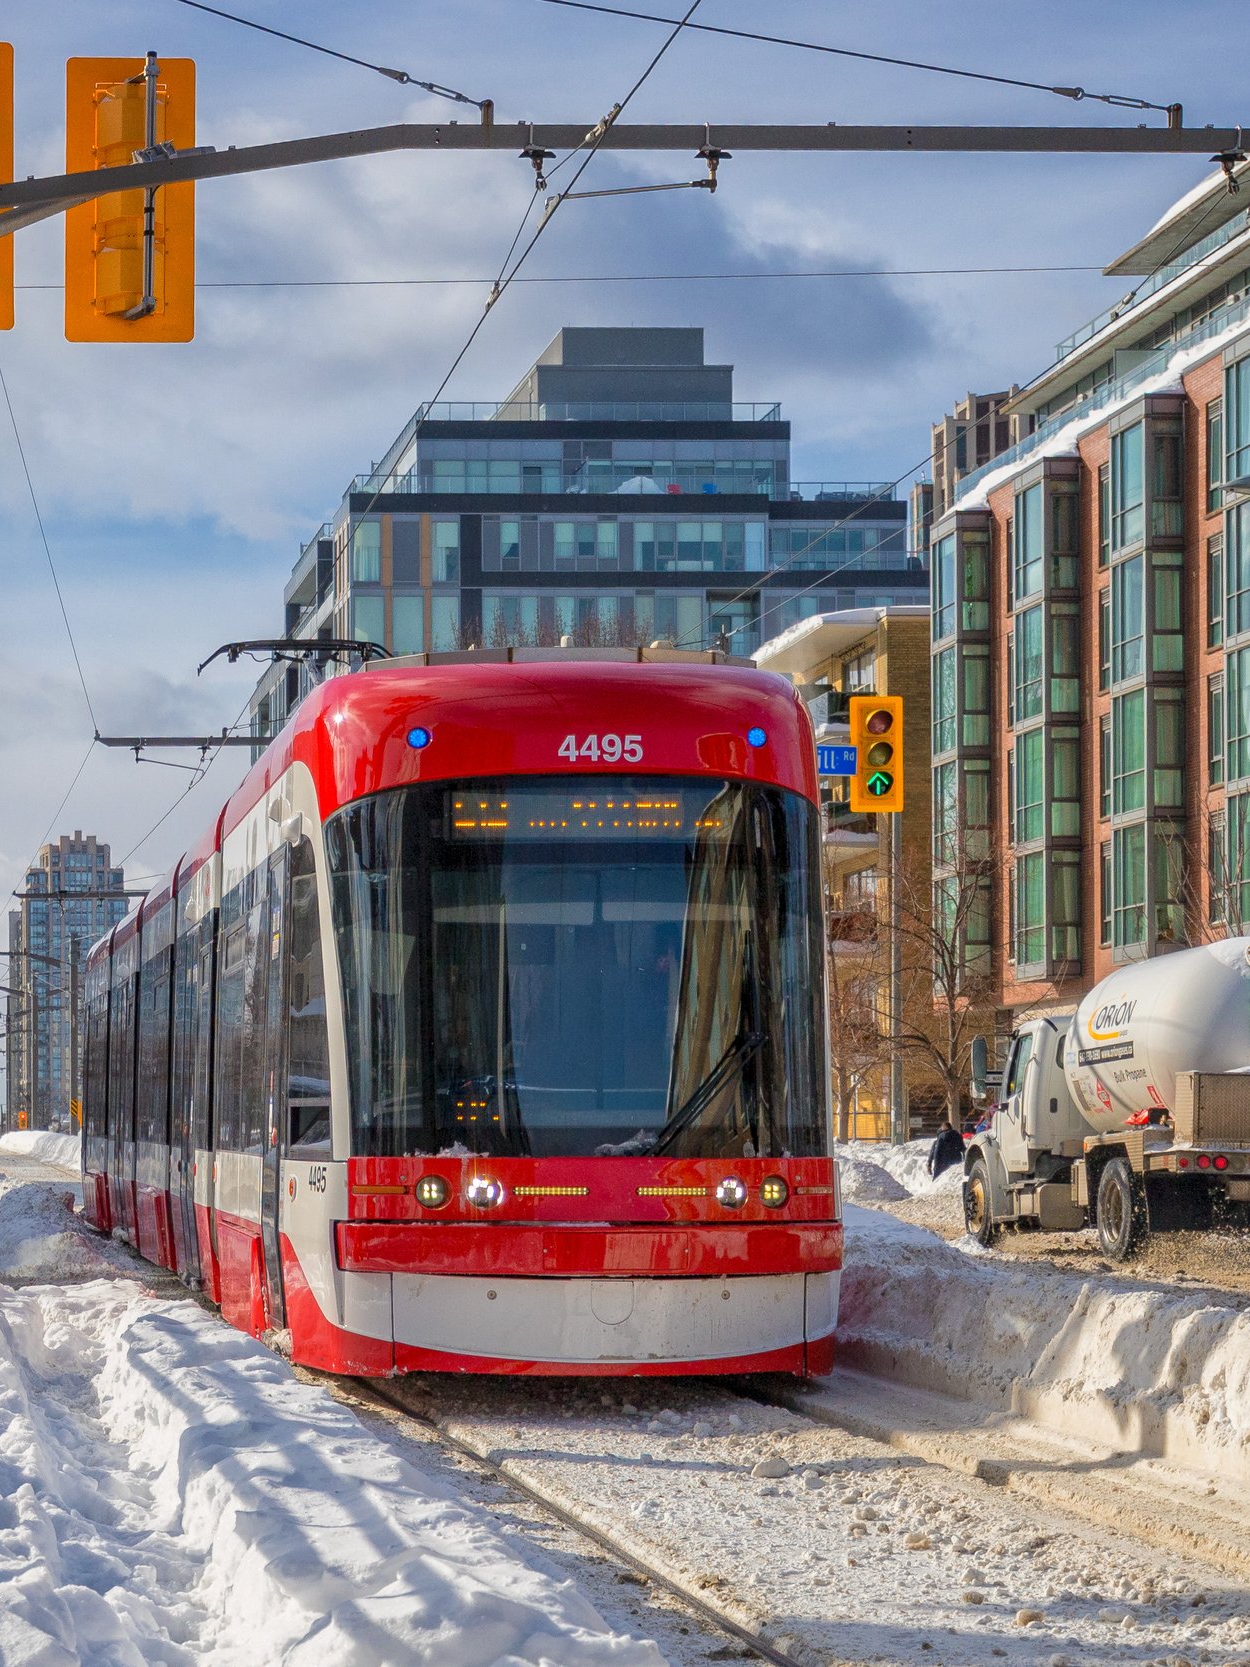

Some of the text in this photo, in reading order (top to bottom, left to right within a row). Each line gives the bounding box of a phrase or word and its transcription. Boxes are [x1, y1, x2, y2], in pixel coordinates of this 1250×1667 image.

[557, 734, 644, 762] 4495
[817, 750, 855, 770] ill Rd
[1096, 999, 1138, 1030] ORION
[1113, 1068, 1147, 1083] Bulk Propane
[308, 1165, 327, 1193] 4495
